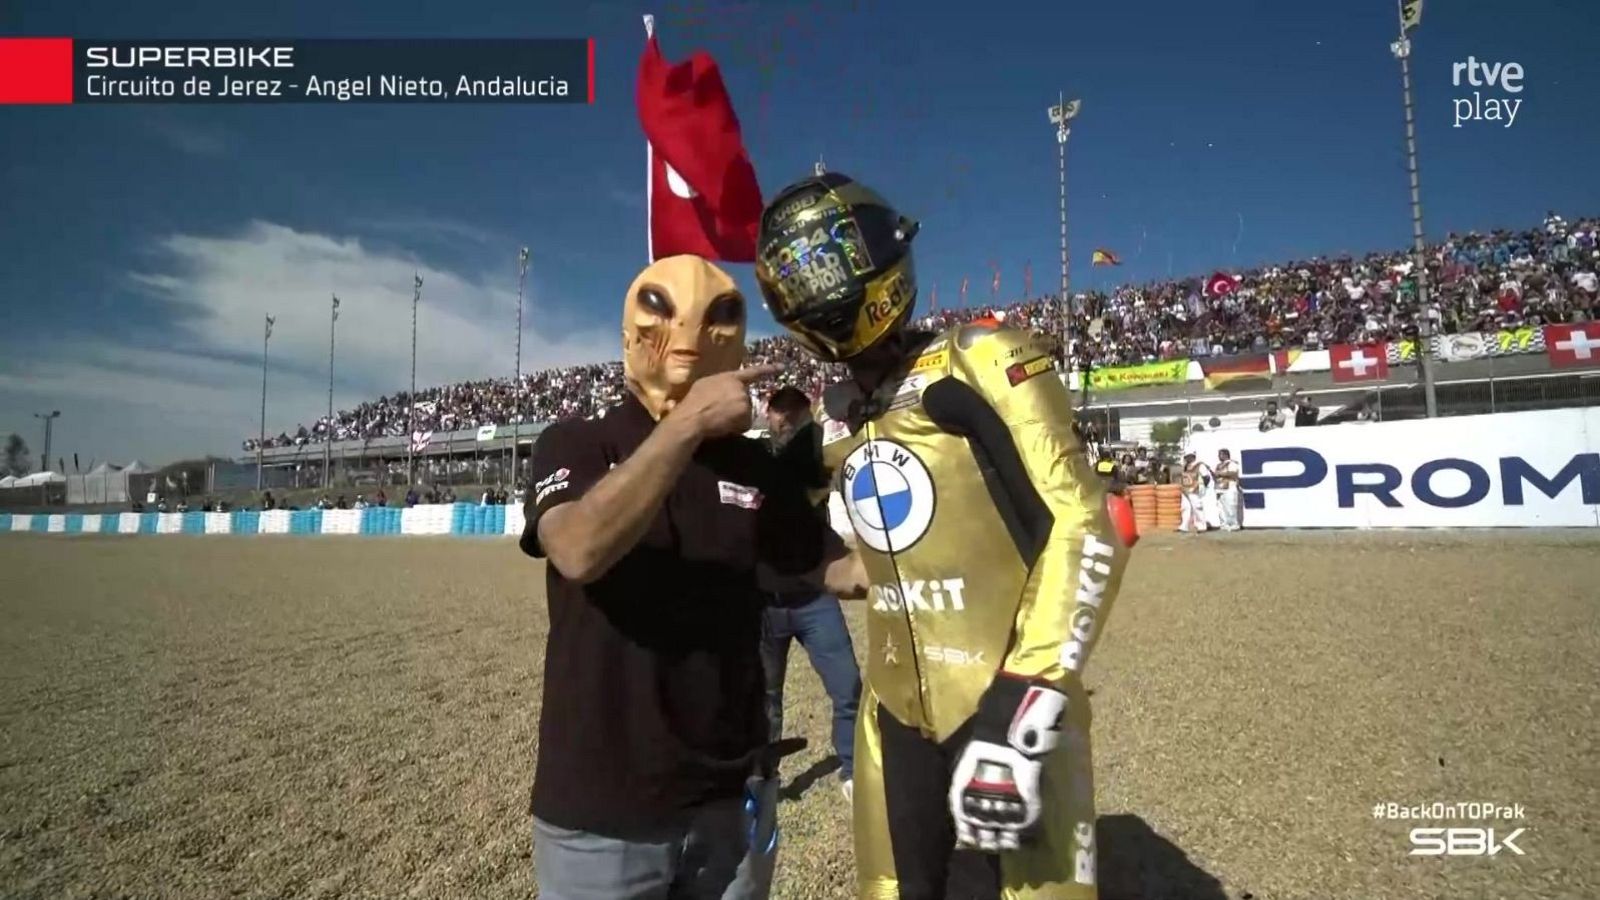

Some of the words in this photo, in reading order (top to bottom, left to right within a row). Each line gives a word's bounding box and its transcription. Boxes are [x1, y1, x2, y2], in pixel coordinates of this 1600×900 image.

[1497, 327, 1534, 351] 77
[844, 444, 910, 481] BMW
[1239, 446, 1600, 510] PROM
[923, 646, 987, 665] SBK
